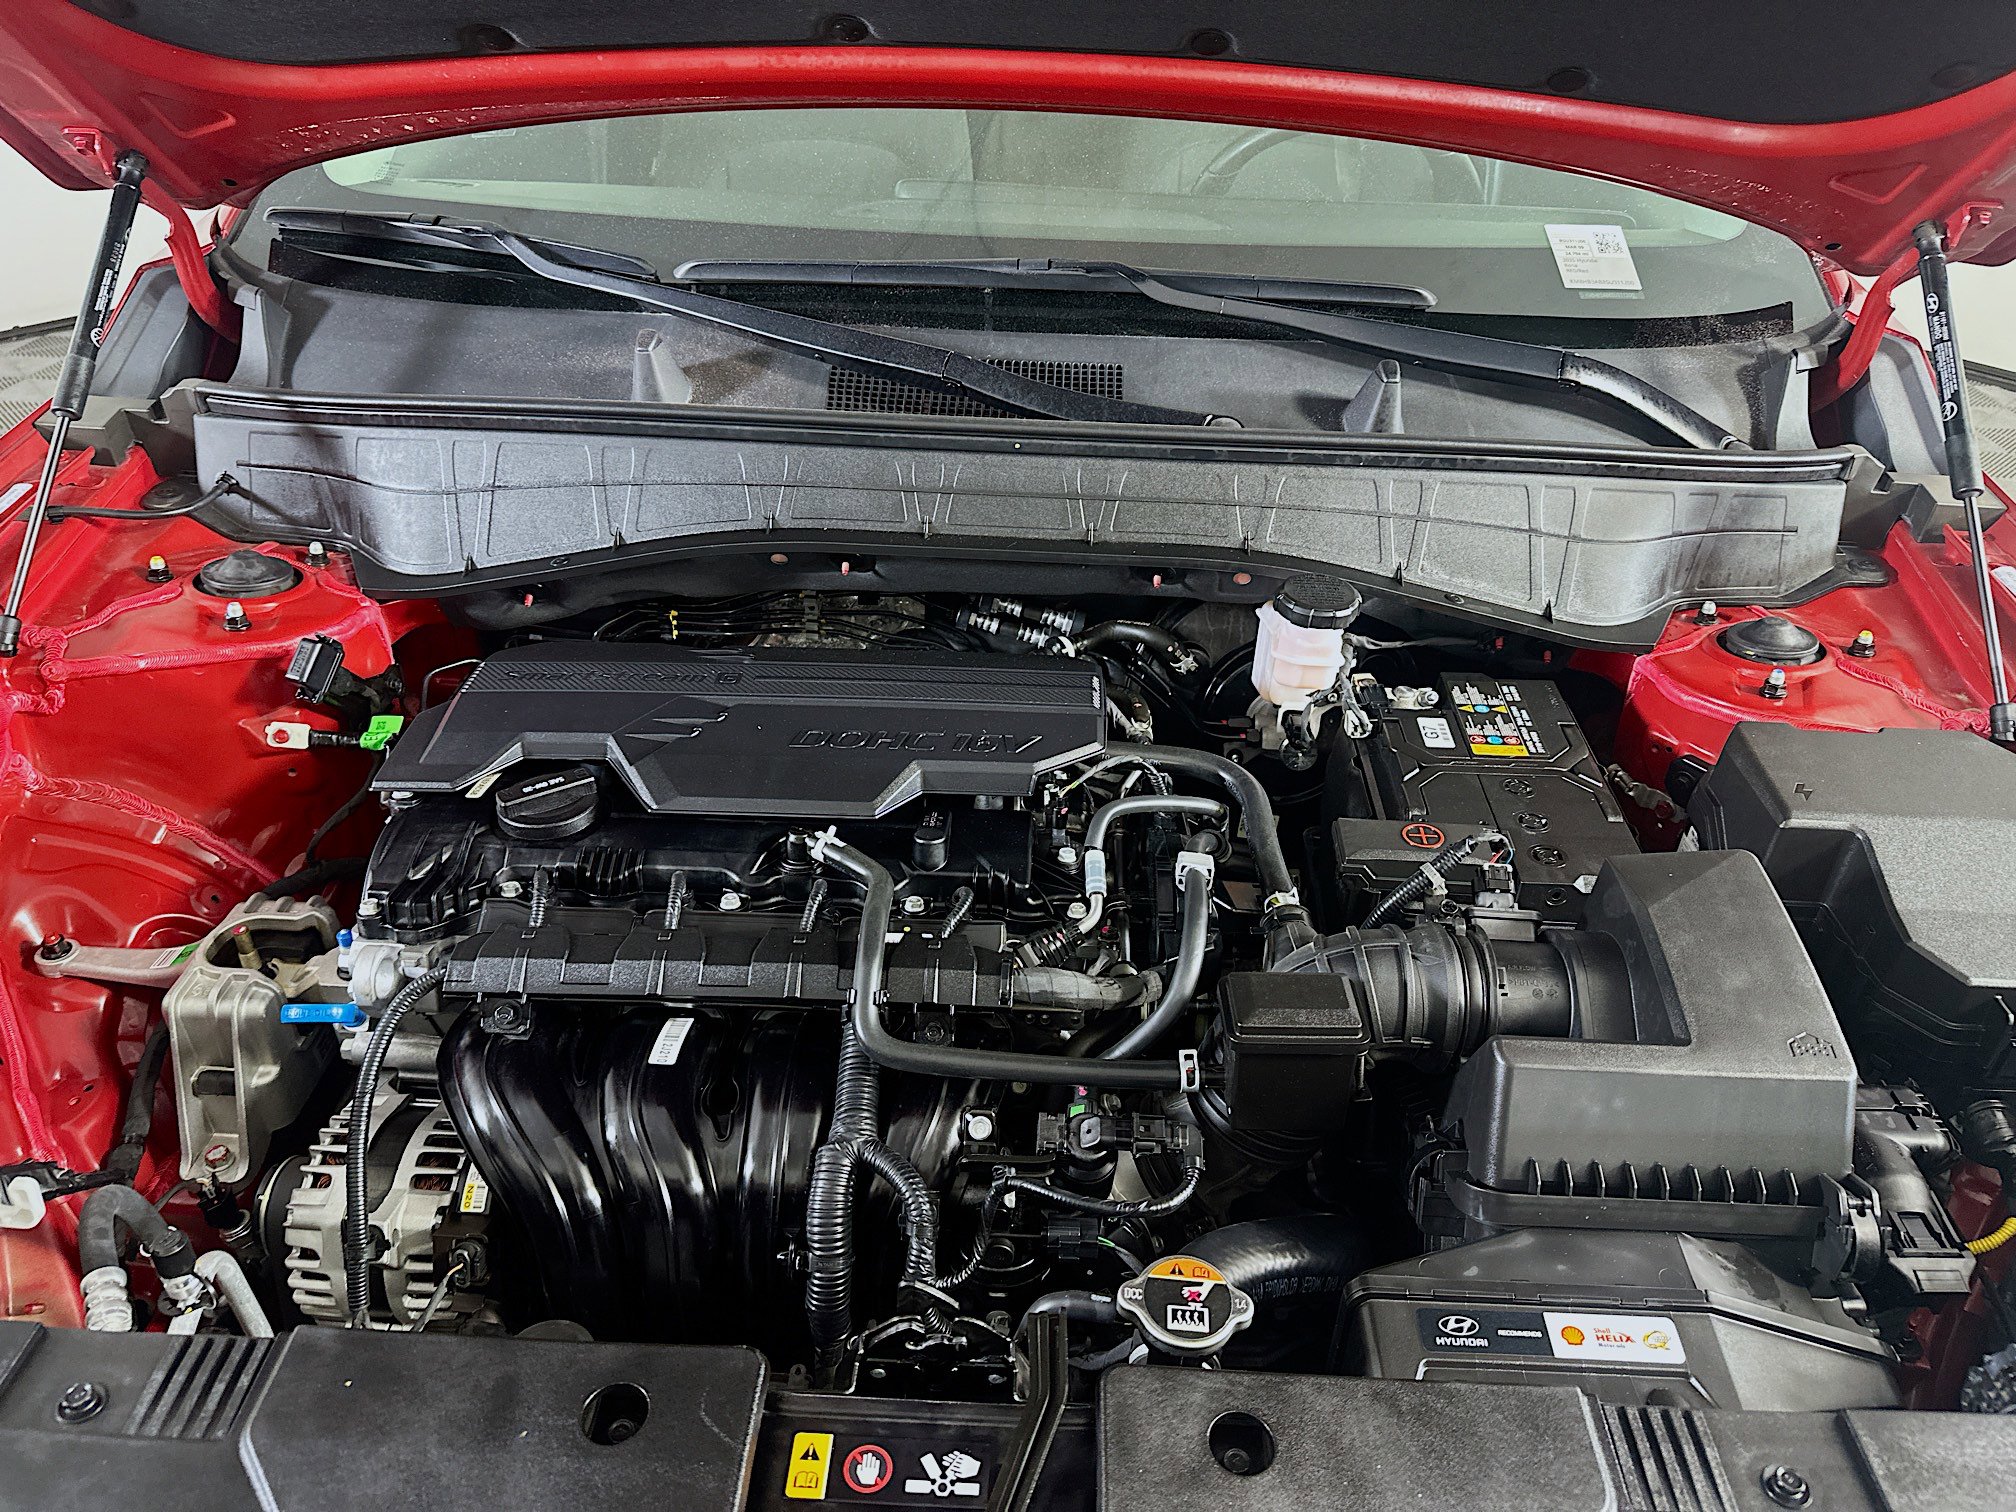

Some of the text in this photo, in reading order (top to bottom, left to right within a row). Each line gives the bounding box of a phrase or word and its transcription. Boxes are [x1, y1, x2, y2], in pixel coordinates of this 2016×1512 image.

[1933, 315, 1942, 339] MANDO
[501, 668, 708, 683] Smartstream
[1422, 725, 1439, 739] G7
[789, 728, 1042, 753] DOHC 16V
[464, 1185, 475, 1208] N20
[1124, 1287, 1143, 1299] DCC
[1497, 1329, 1543, 1338] RECOMMENDS
[1595, 1332, 1636, 1344] HELIX
[1435, 1336, 1489, 1347] HYUNDAI
